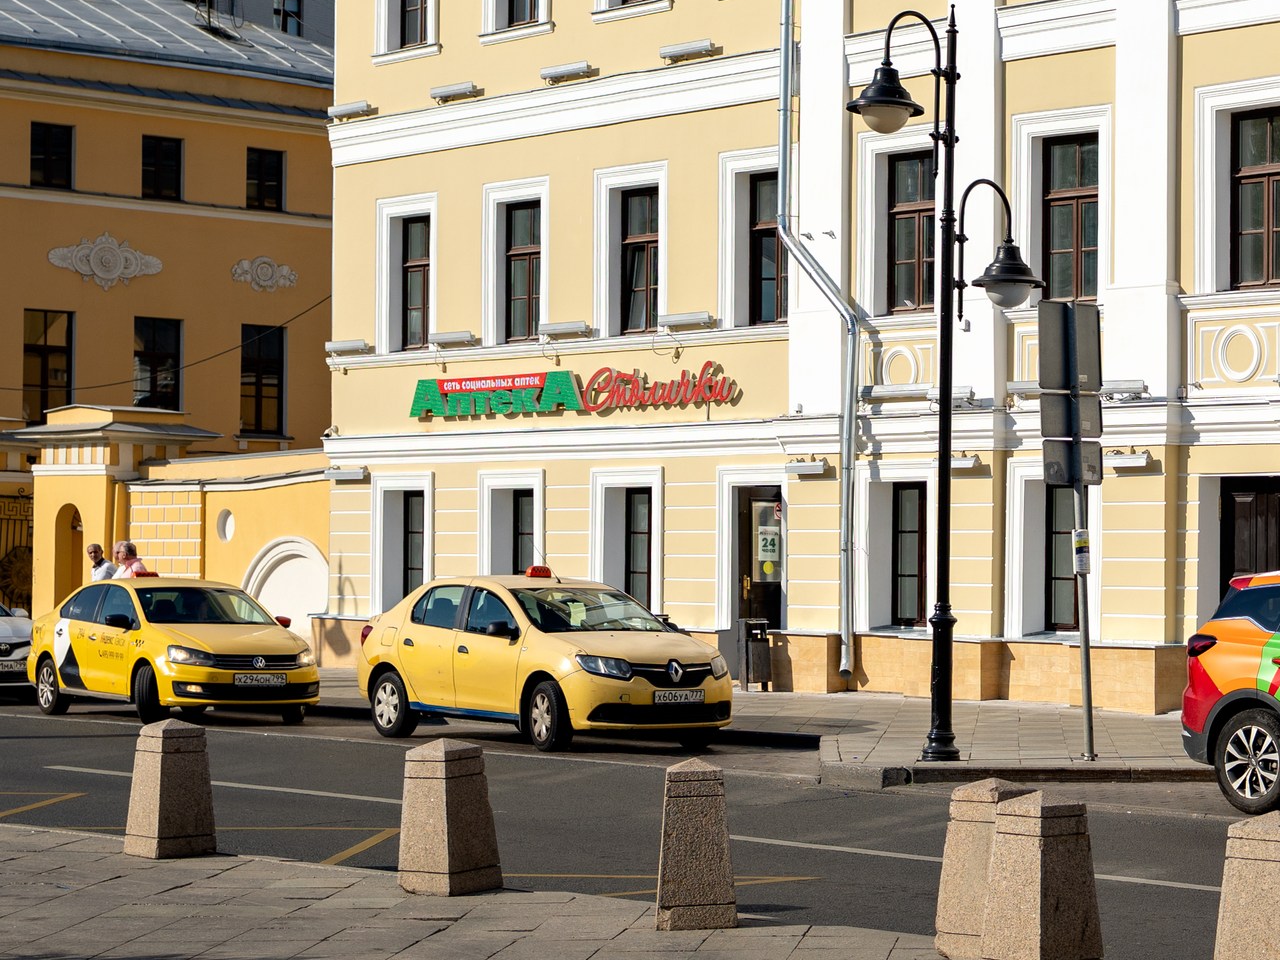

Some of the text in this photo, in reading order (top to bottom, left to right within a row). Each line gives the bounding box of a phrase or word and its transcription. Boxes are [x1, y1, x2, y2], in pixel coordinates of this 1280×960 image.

[443, 376, 540, 391] сеть социальных аптек
[583, 360, 734, 412] Столички
[762, 537, 776, 548] 24
